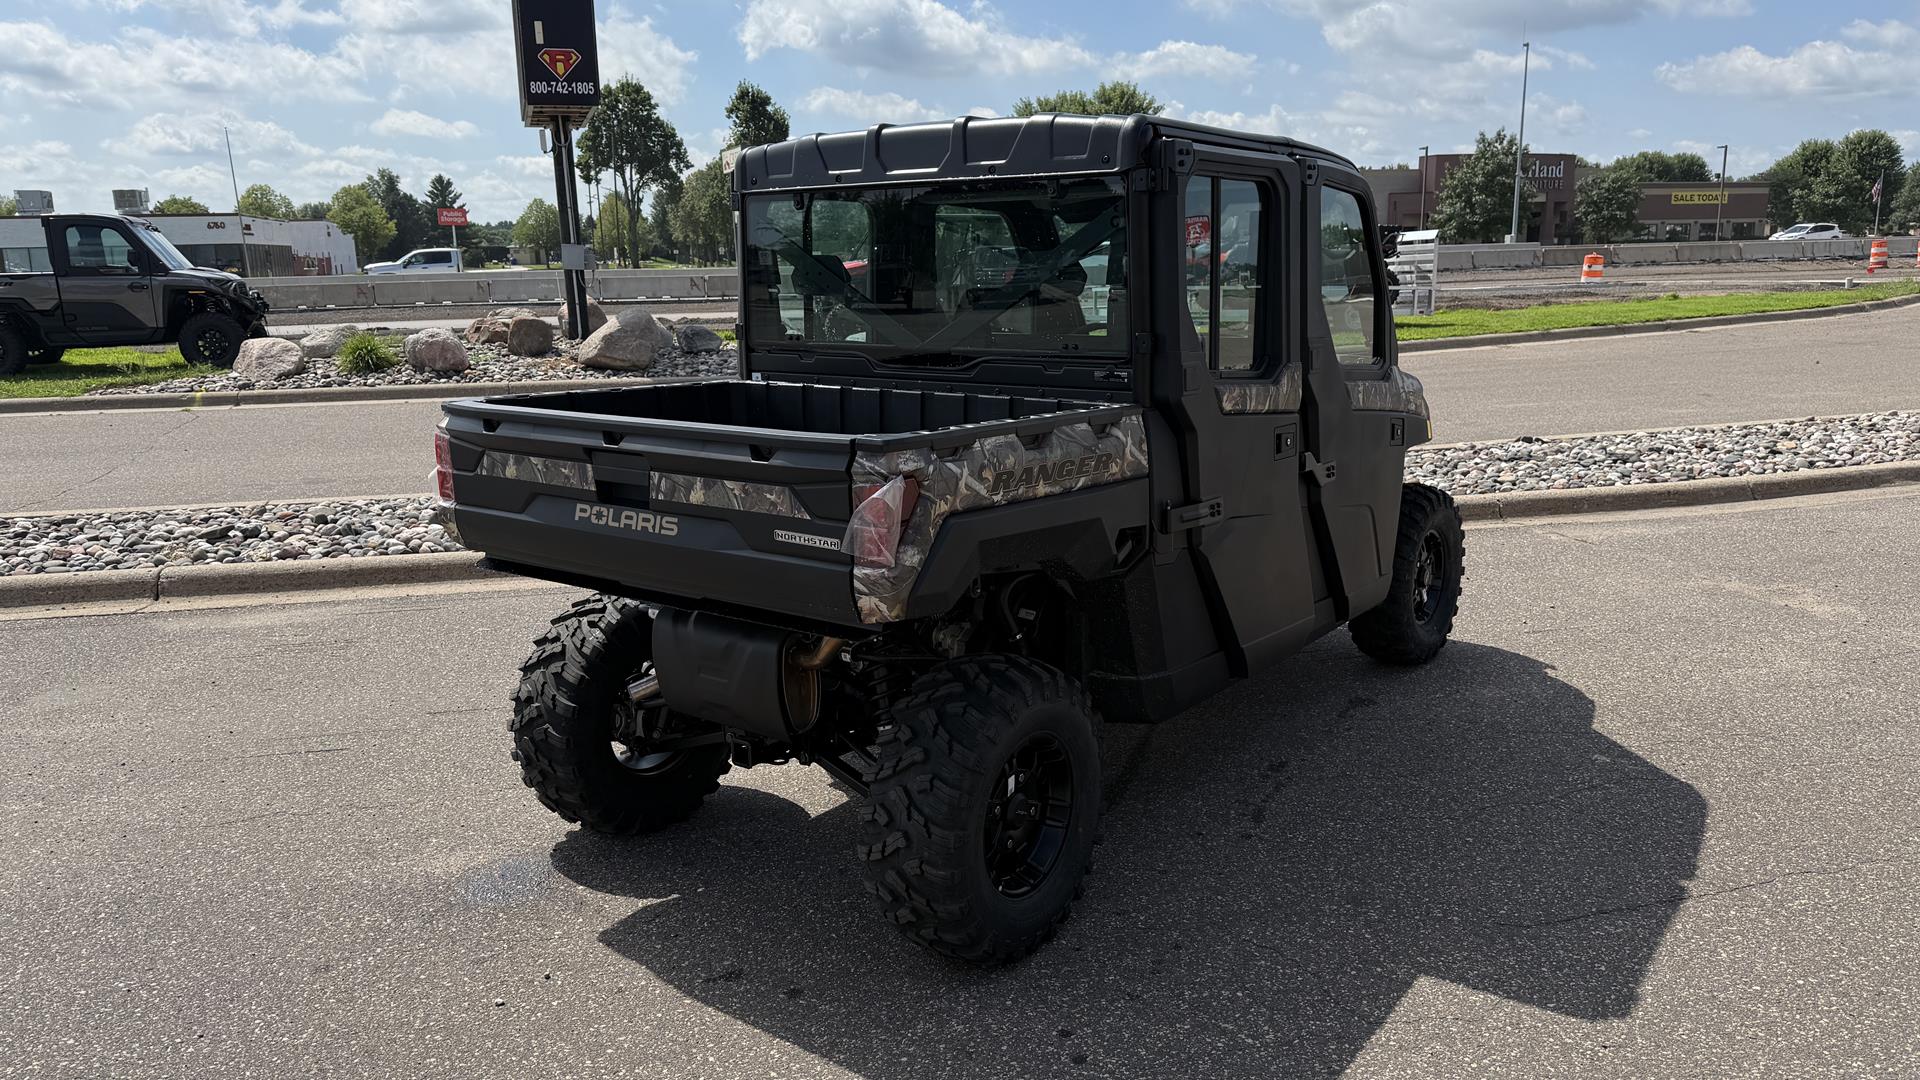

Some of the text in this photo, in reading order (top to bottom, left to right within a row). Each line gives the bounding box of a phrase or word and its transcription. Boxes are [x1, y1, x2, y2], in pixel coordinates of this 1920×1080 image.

[530, 81, 595, 94] 800-742-1805
[1673, 194, 1695, 202] SALE
[989, 452, 1113, 495] RANGER
[574, 503, 679, 536] POLARIS
[776, 532, 837, 549] NORTHSTAR
